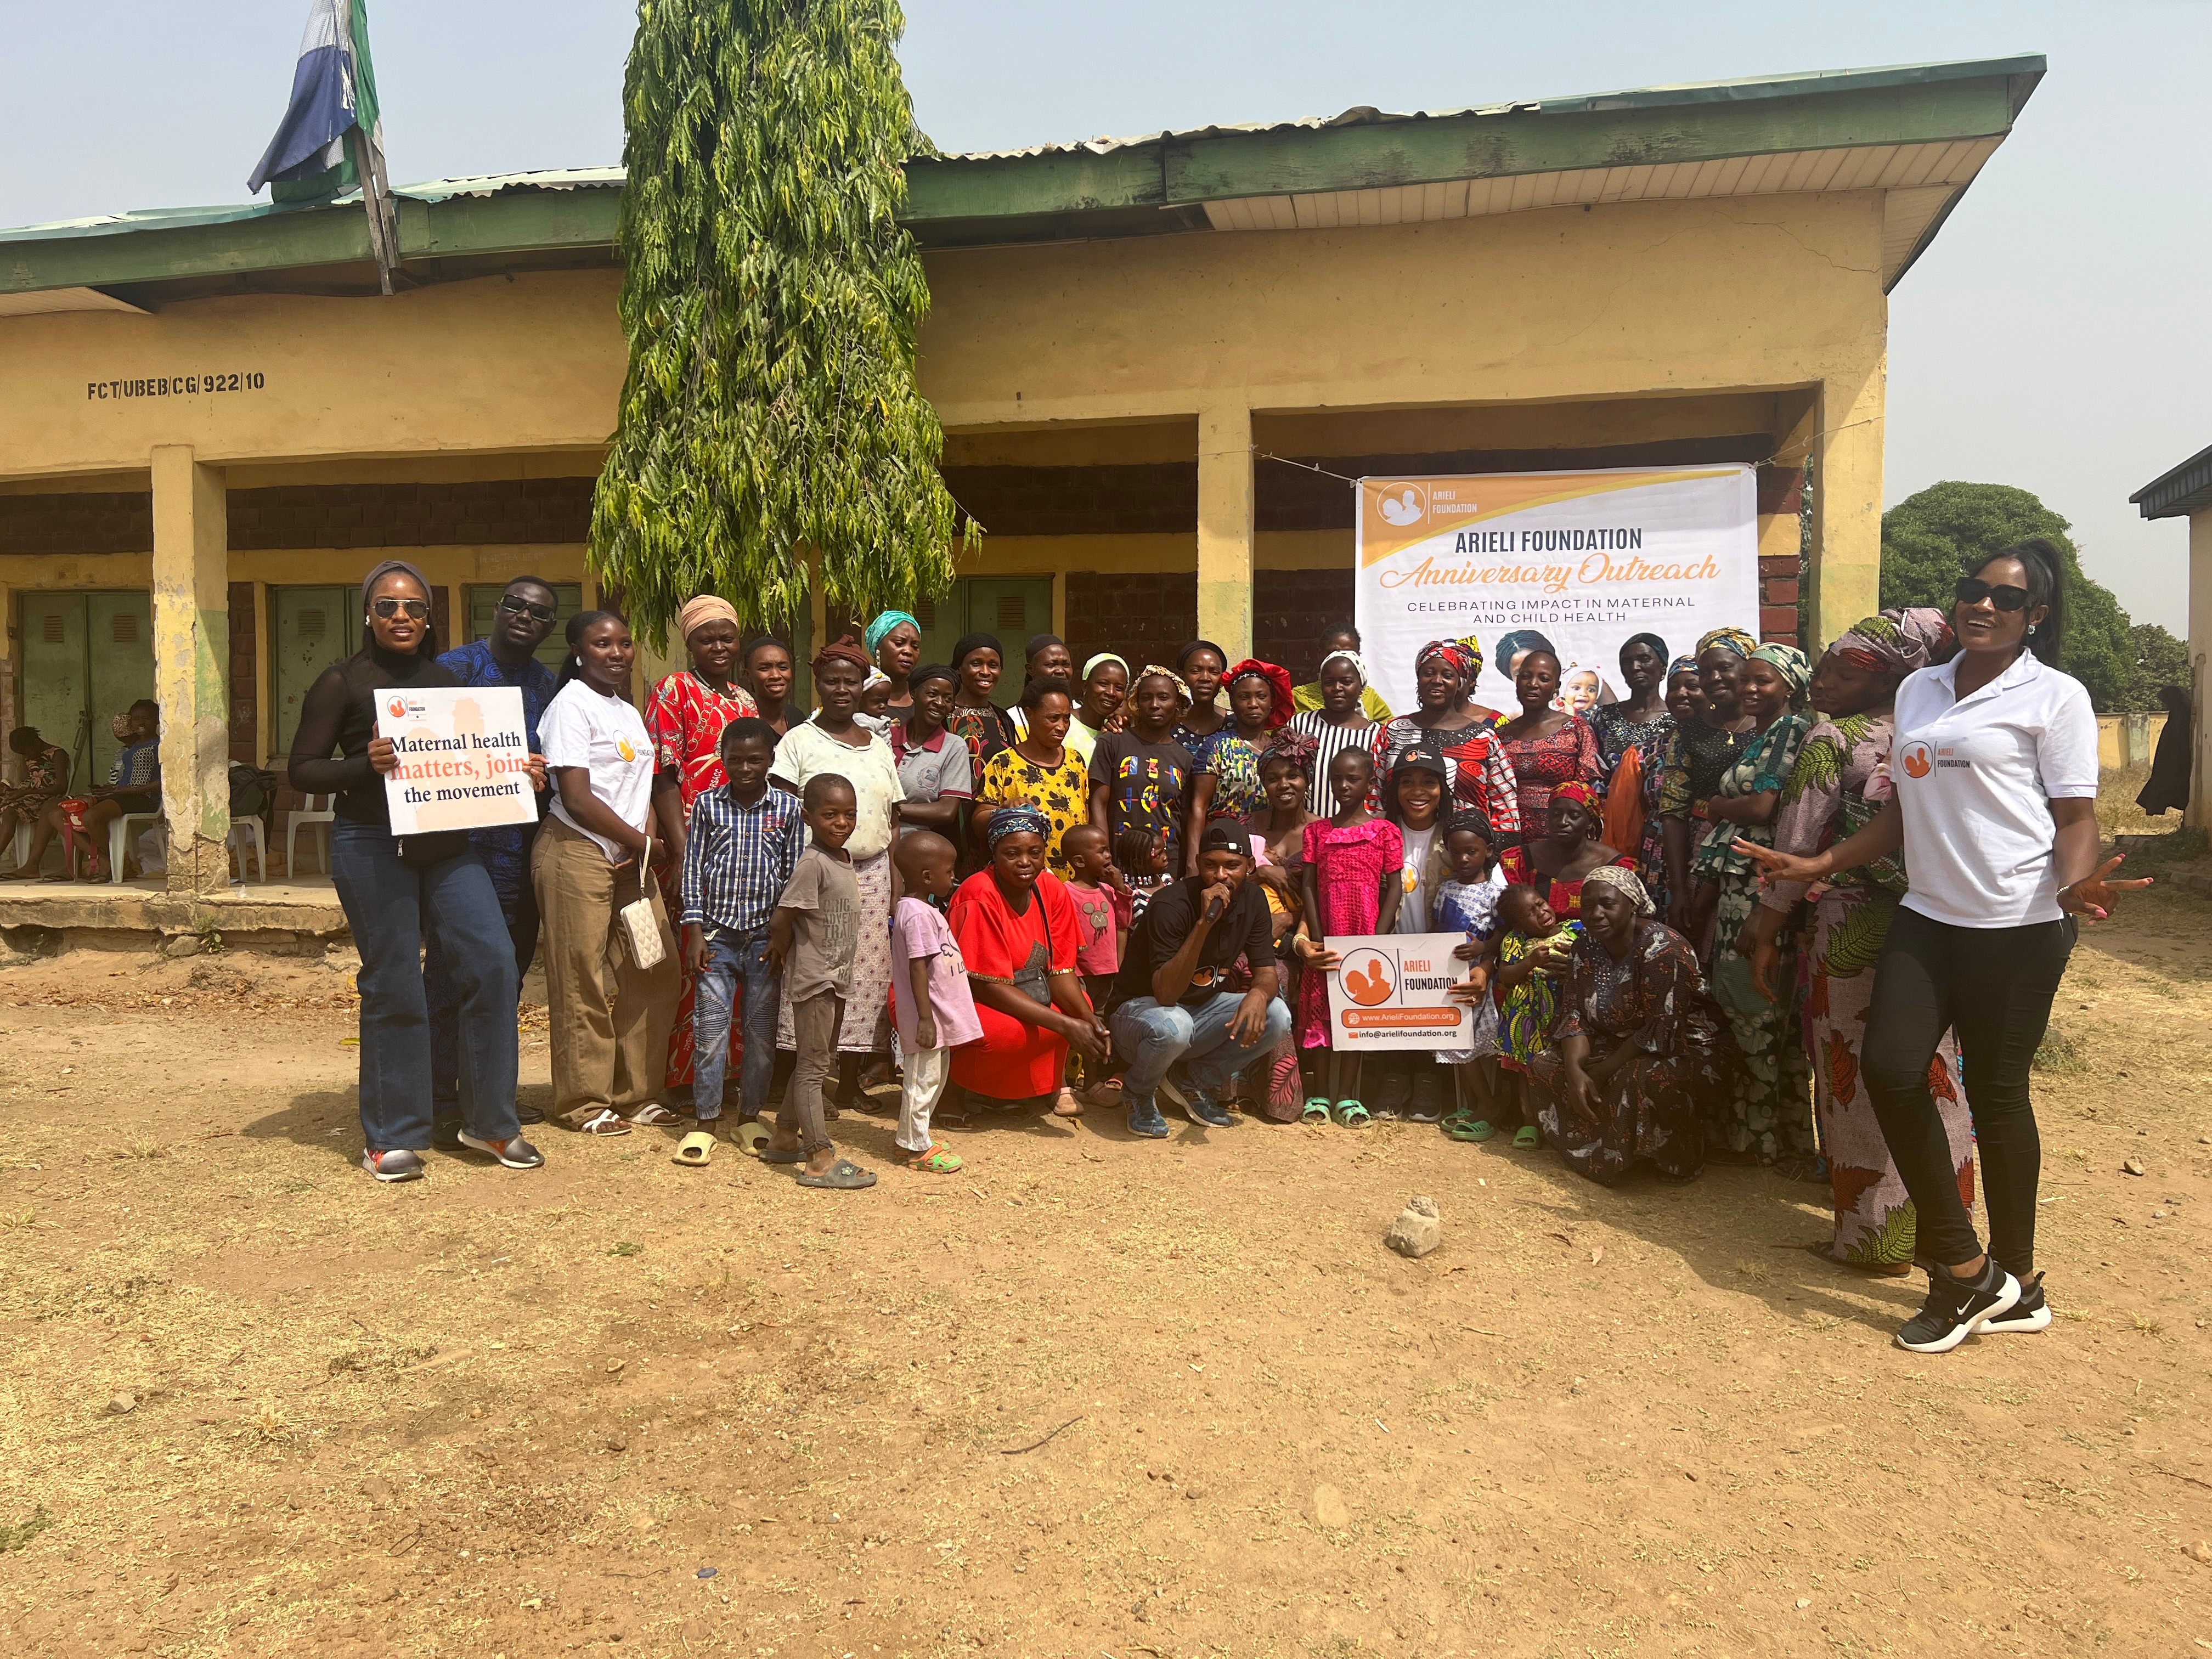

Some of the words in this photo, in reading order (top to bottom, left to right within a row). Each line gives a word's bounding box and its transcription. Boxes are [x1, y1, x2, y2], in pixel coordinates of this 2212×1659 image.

[1432, 490, 1455, 500] ARIELI
[1432, 503, 1477, 514] FOUNDATION
[1455, 531, 1514, 553] ARIELI
[1522, 528, 1641, 551] FOUNDATION
[1380, 556, 1573, 594] Anniversary
[1577, 552, 1721, 584] Outreach
[1408, 600, 1516, 612] CELEBRATING
[1522, 599, 1581, 610] IMPACT
[1587, 599, 1601, 608] IN
[1607, 597, 1695, 608] MATERNAL
[1473, 614, 1505, 623] AND
[1511, 613, 1559, 623] CHILD
[1564, 612, 1626, 622] HEALTH
[390, 733, 467, 753] Maternal
[471, 731, 521, 749] health
[390, 759, 479, 781] matters,
[486, 752, 524, 780] join
[1937, 759, 1970, 768] FOUNDATION
[404, 786, 432, 803] the
[436, 782, 521, 800] movement
[824, 923, 855, 939] TRAIL
[1404, 960, 1431, 972] ARIELI
[1362, 1013, 1454, 1021] www.ArieliFoundation.org
[1359, 1030, 1457, 1039] info@arielifoundation.org
